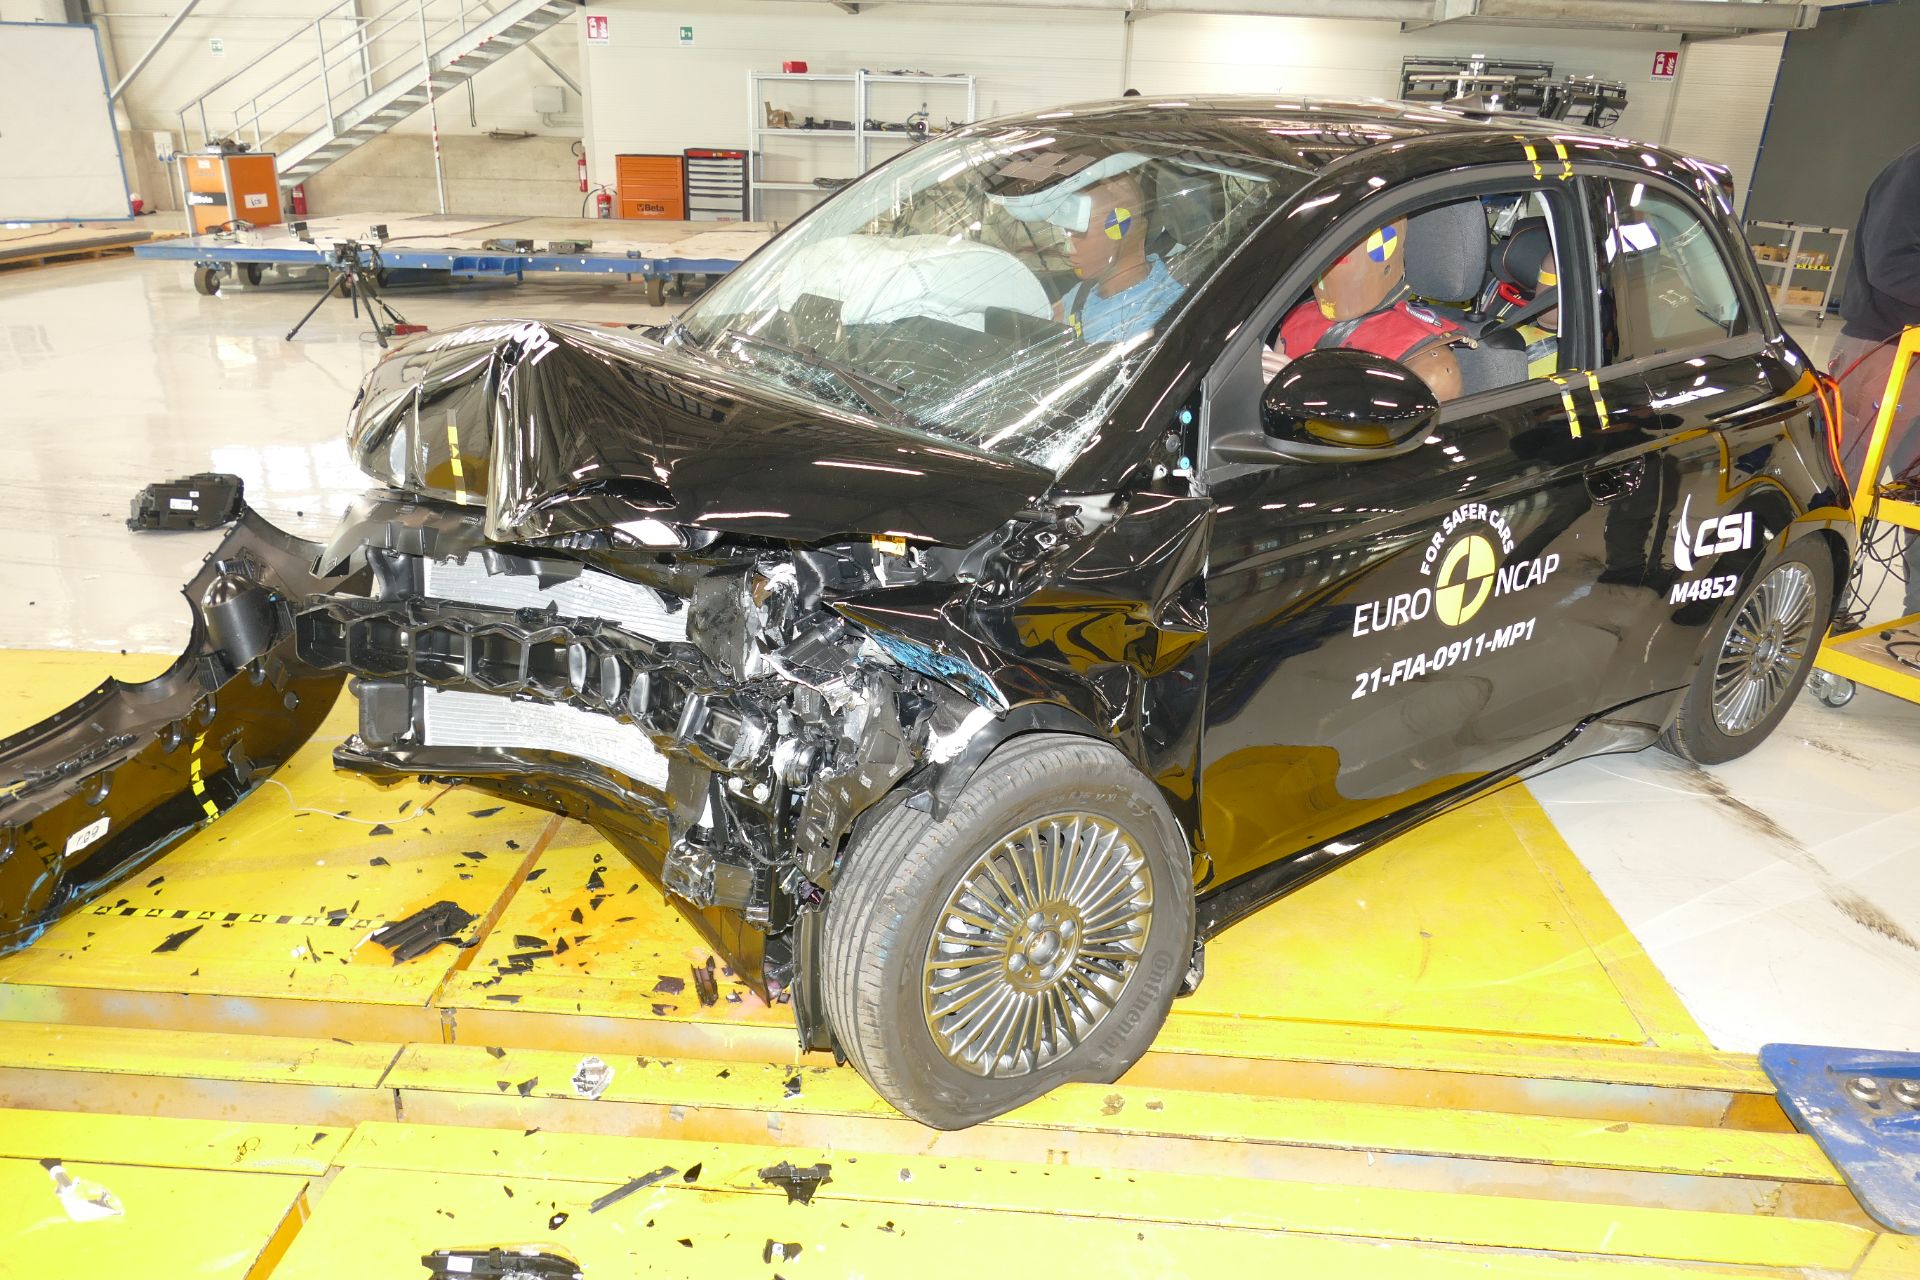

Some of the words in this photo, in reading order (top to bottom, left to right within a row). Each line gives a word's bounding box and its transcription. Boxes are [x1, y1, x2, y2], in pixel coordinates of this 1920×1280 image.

[644, 203, 665, 212] Beta
[1420, 531, 1446, 576] FOR
[1443, 502, 1488, 535] SAFER
[1489, 509, 1515, 555] CARS
[1693, 511, 1754, 558] CSI
[1352, 587, 1432, 638] EURO
[1494, 553, 1560, 598] NCAP
[1669, 574, 1738, 605] M4852
[1351, 616, 1537, 700] 21-FIA-0911-MP1
[1100, 950, 1175, 1058] Continental
